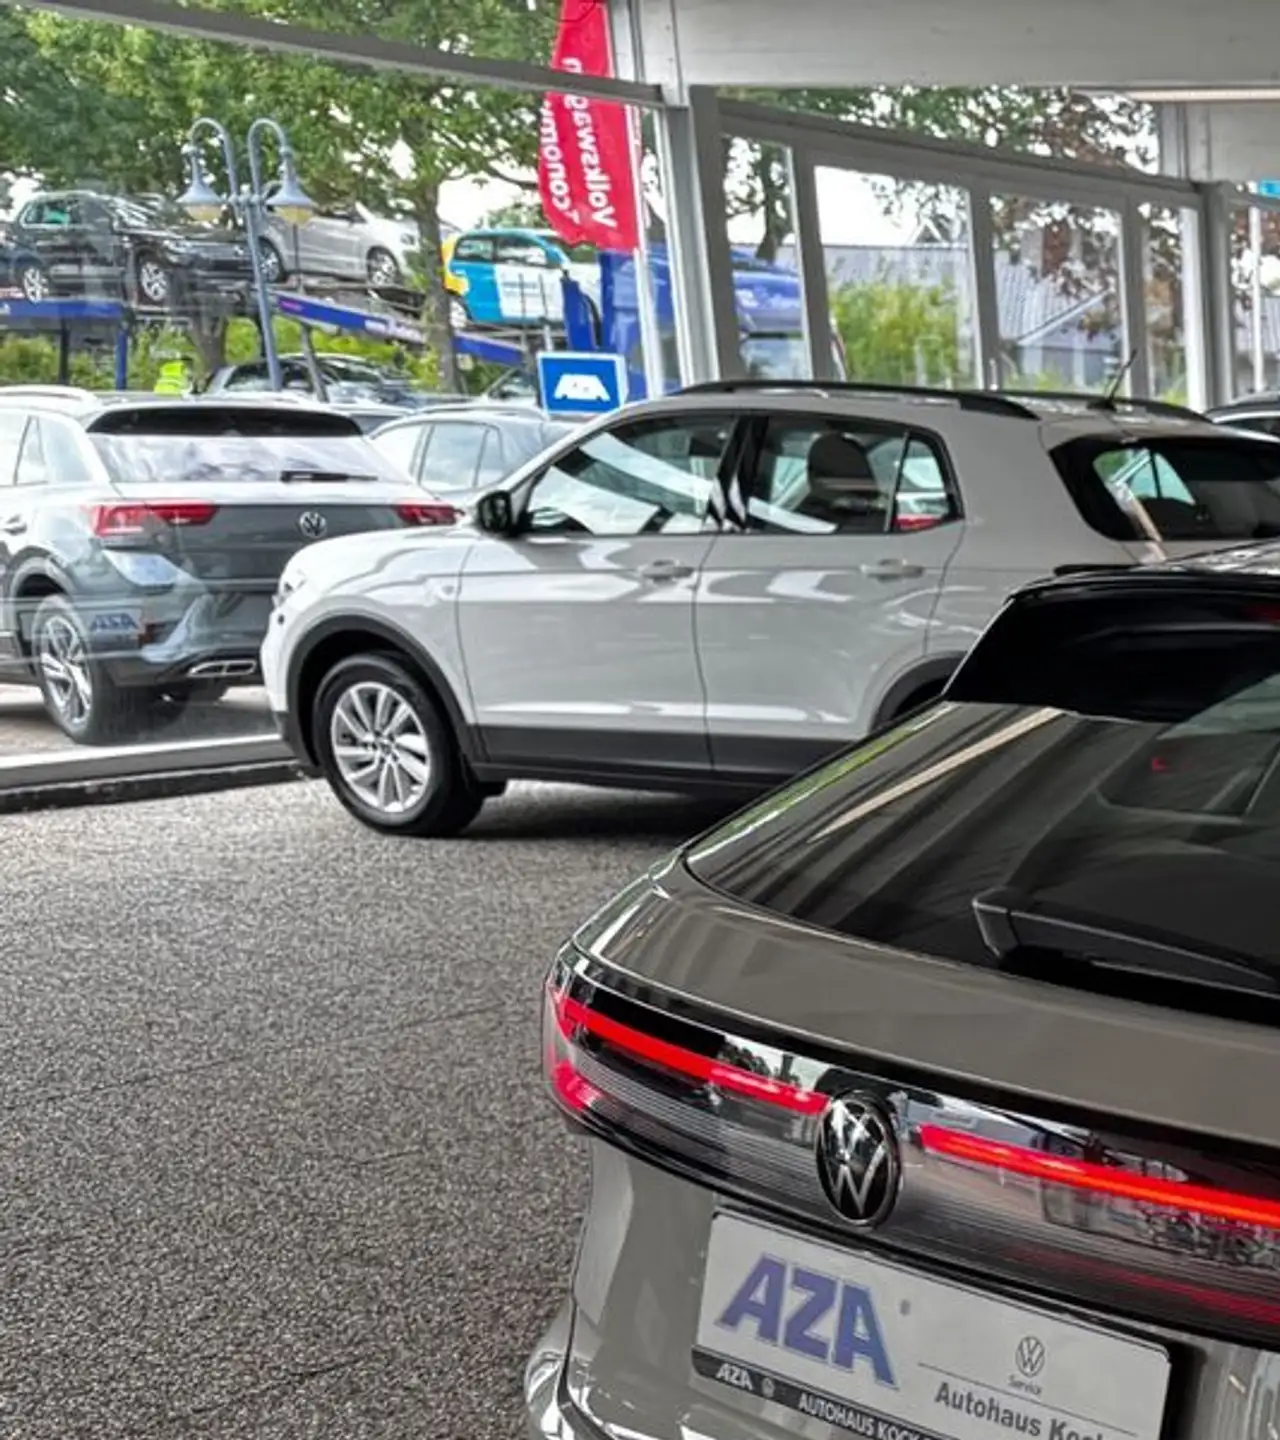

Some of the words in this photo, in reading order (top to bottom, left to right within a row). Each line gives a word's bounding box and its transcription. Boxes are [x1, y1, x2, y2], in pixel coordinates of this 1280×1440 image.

[715, 1252, 899, 1391] AZA
[715, 1363, 754, 1391] AZA
[1007, 1374, 1043, 1396] Service
[798, 1392, 874, 1436] AUTOHAUS
[934, 1381, 1042, 1438] Autohaus
